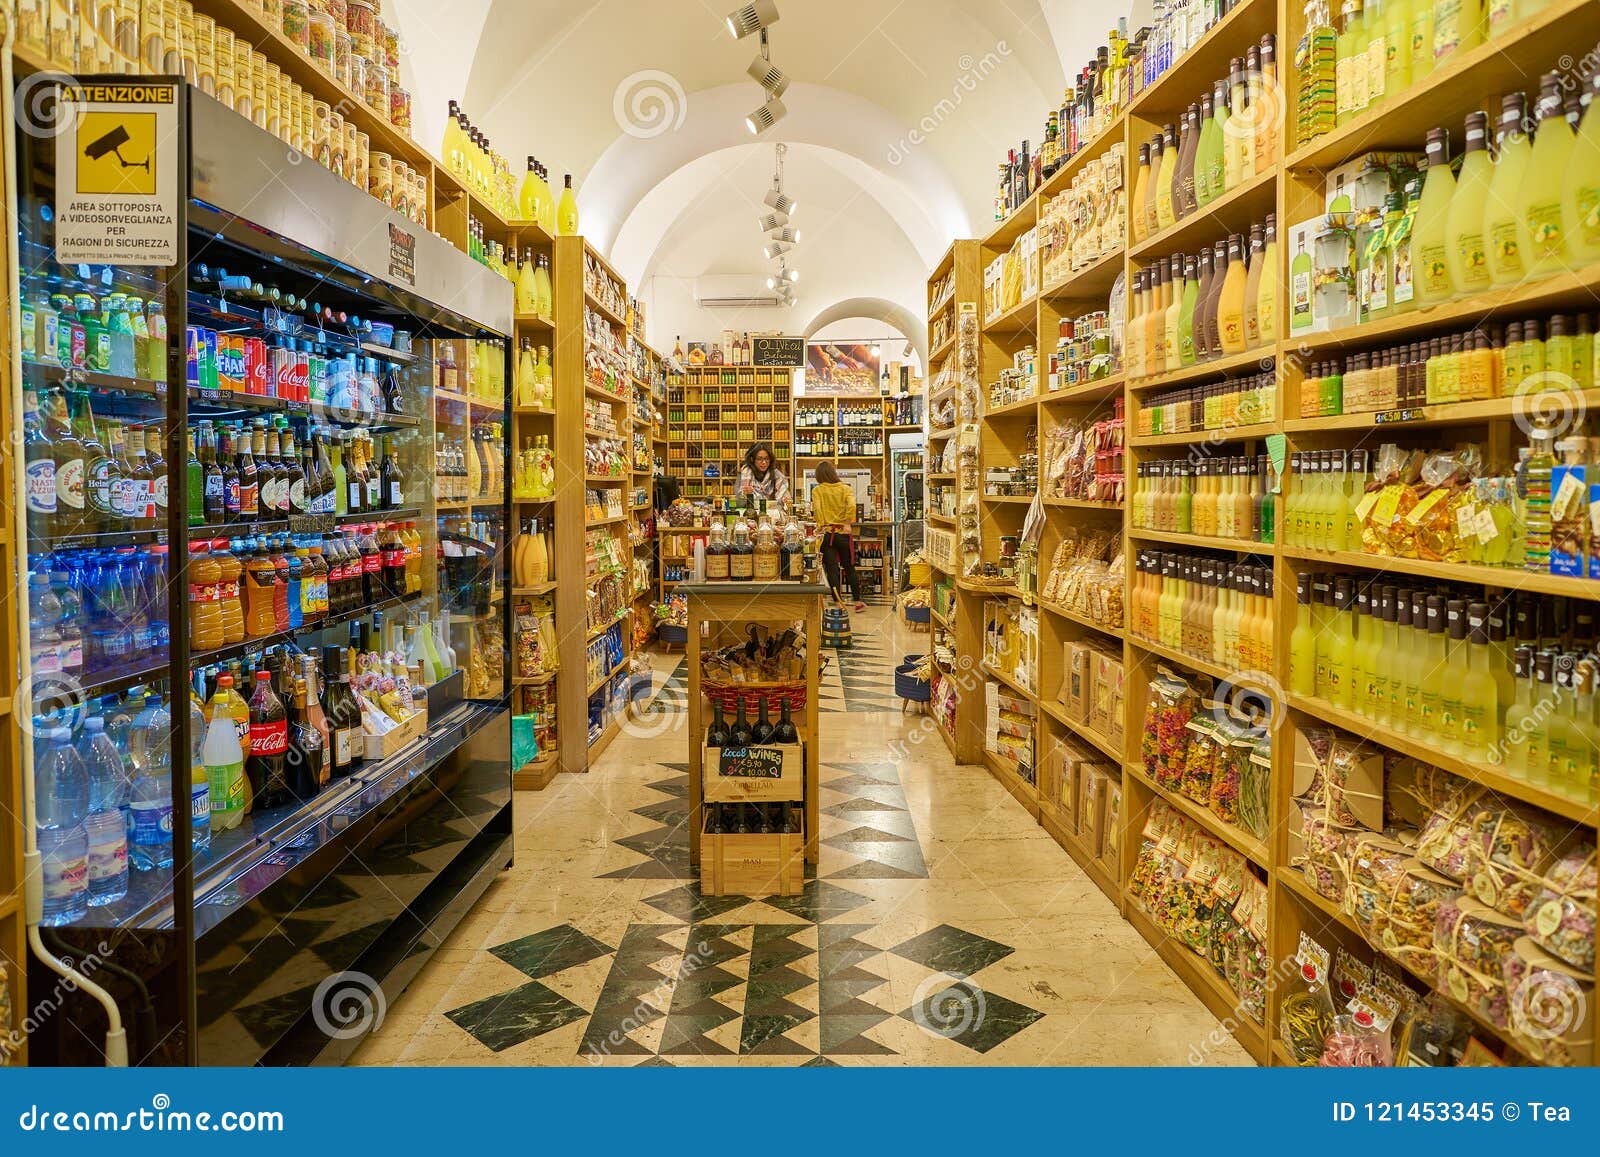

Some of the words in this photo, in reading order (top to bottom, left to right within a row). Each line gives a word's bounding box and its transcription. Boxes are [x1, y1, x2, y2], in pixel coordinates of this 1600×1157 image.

[61, 86, 174, 103] ATTENZIONE!
[70, 202, 96, 211] AREA
[98, 203, 163, 213] SOTTOPOSTA
[59, 214, 67, 223] A
[69, 214, 173, 225] VIDEOSORVEGLIANZA
[106, 226, 126, 236] PER
[62, 238, 102, 248] RAGIONI
[104, 238, 114, 247] DI
[116, 238, 170, 249] SICUREZZA
